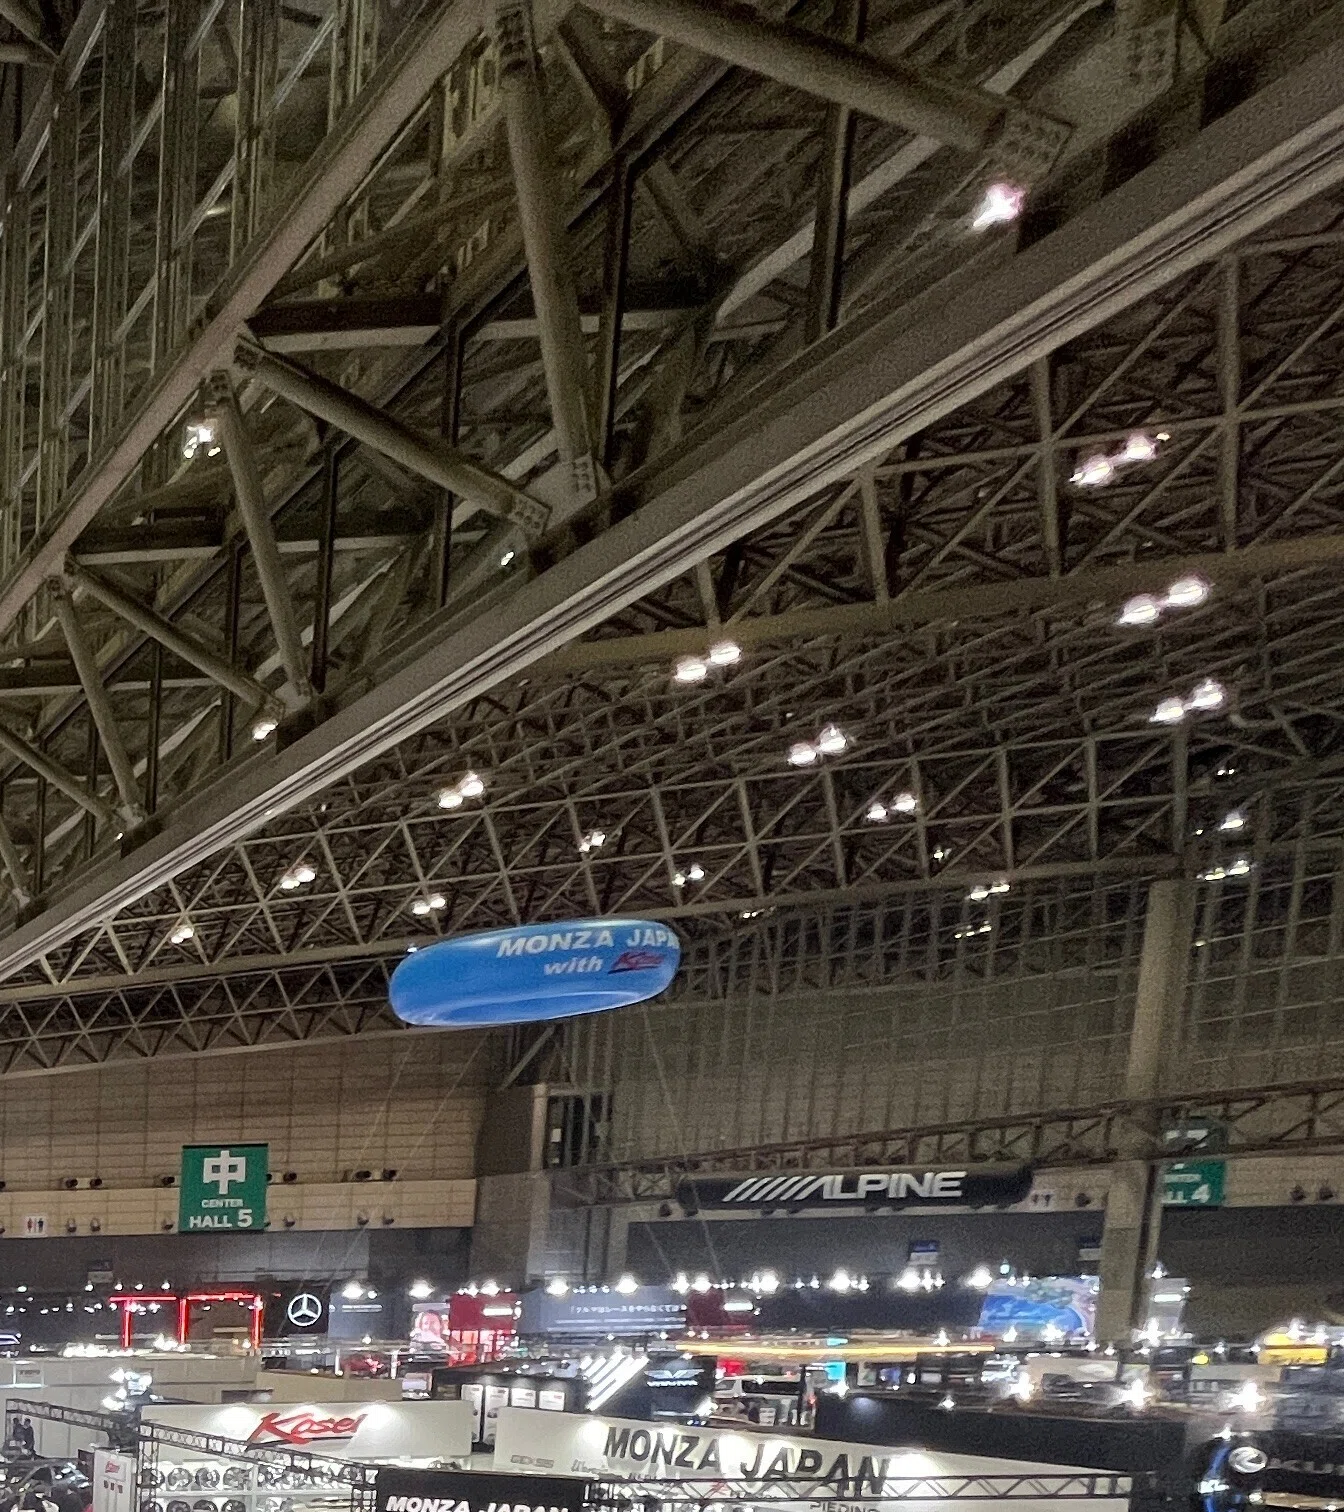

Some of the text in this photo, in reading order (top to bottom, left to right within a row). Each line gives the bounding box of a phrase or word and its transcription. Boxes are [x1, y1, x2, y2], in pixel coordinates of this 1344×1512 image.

[496, 930, 613, 958] MONZA
[544, 955, 603, 976] with
[203, 1150, 246, 1194] 中
[788, 1171, 967, 1201] ALPINE
[189, 1208, 253, 1229] HALL 5
[603, 1426, 891, 1499] MONZA JAPAN
